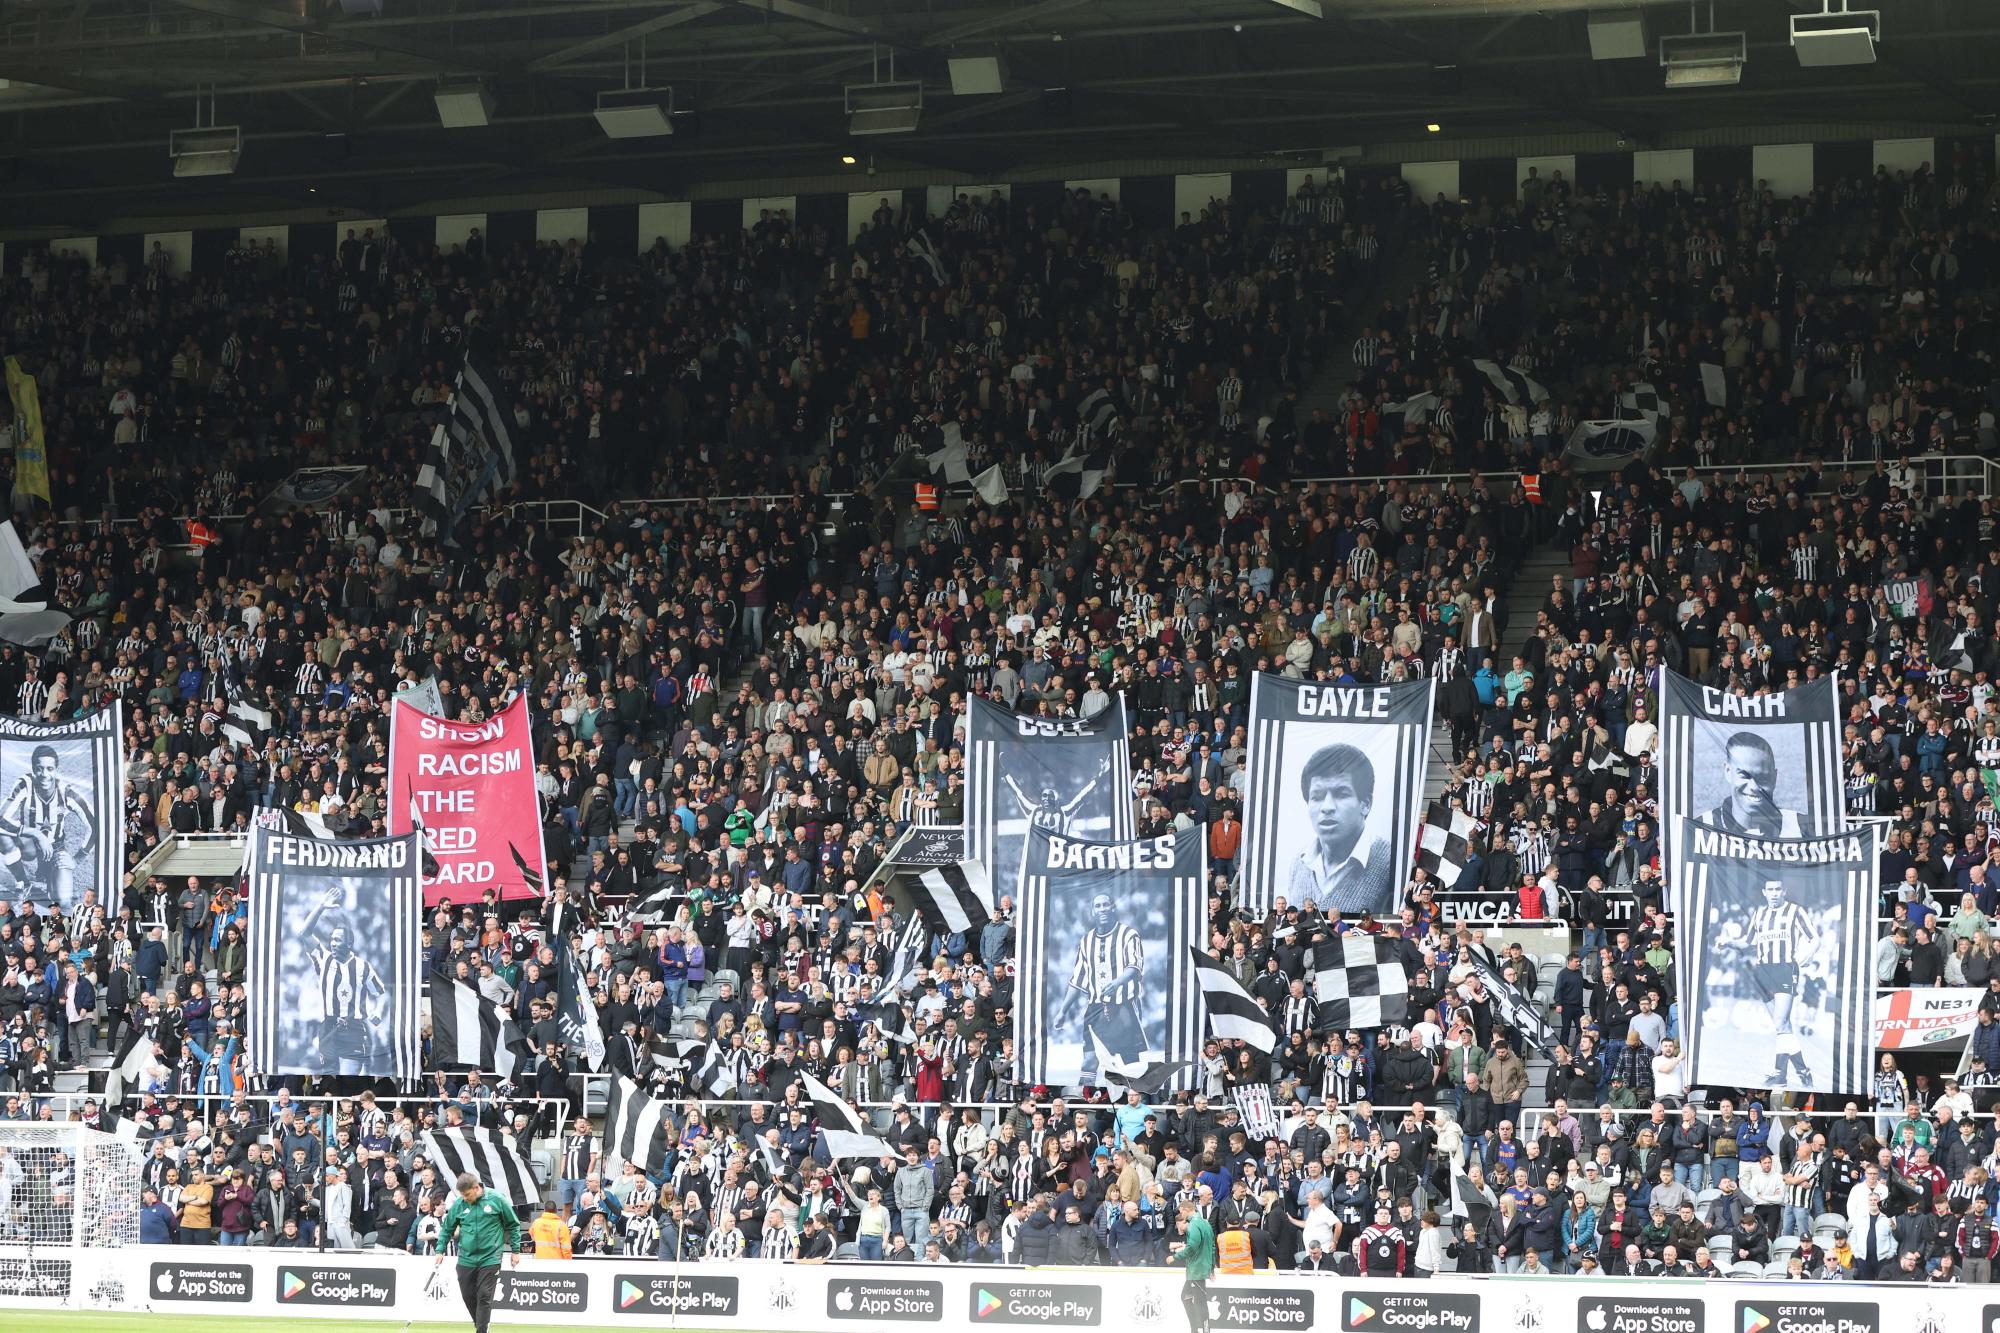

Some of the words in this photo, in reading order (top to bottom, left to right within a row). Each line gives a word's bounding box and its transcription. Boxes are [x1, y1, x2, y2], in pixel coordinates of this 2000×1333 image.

[1297, 685, 1391, 717] GAYLE
[1702, 685, 1786, 718] CARR
[419, 717, 504, 742] SHOW
[418, 748, 521, 776] RACISM
[417, 790, 475, 812] THE
[266, 836, 407, 868] FERDINAND
[1047, 834, 1176, 869] BARNES
[1694, 828, 1863, 862] MIRANDINHA
[1924, 1000, 1973, 1010] NE31
[558, 1012, 583, 1043] THE
[1918, 1011, 1978, 1028] MAGS
[179, 1269, 216, 1278] Download
[229, 1271, 242, 1279] the
[312, 1272, 328, 1280] GET
[329, 1272, 337, 1280] IT
[511, 1278, 548, 1287] Download
[563, 1280, 576, 1288] the
[178, 1278, 206, 1296] App
[209, 1280, 245, 1294] Store
[311, 1282, 359, 1301] Google
[361, 1283, 389, 1302] Play
[651, 1280, 667, 1288] GET
[678, 1281, 691, 1289] ON
[861, 1287, 901, 1295] Download
[916, 1288, 930, 1296] the
[1009, 1289, 1027, 1297] GET
[509, 1288, 539, 1306] App
[541, 1289, 580, 1304] Store
[650, 1291, 700, 1310] Google
[702, 1292, 731, 1311] Play
[859, 1297, 890, 1315] App
[893, 1298, 934, 1313] Store
[1228, 1296, 1271, 1304] Download
[1286, 1297, 1301, 1305] the
[1383, 1298, 1401, 1306] GET
[1413, 1299, 1428, 1307] ON
[1008, 1300, 1061, 1320] Google
[1063, 1301, 1094, 1320] Play
[1227, 1306, 1260, 1324] App
[1263, 1307, 1305, 1322] Store
[1614, 1305, 1659, 1314] Download
[1675, 1306, 1691, 1314] the
[1778, 1306, 1797, 1315] GET
[1799, 1307, 1808, 1315] IT
[1809, 1307, 1825, 1316] ON
[1382, 1309, 1438, 1329] Google
[1440, 1310, 1472, 1330] Play
[1612, 1315, 1648, 1333] App
[1651, 1316, 1696, 1332] Store
[1777, 1318, 1836, 1333] Google
[1838, 1320, 1871, 1333] Play
